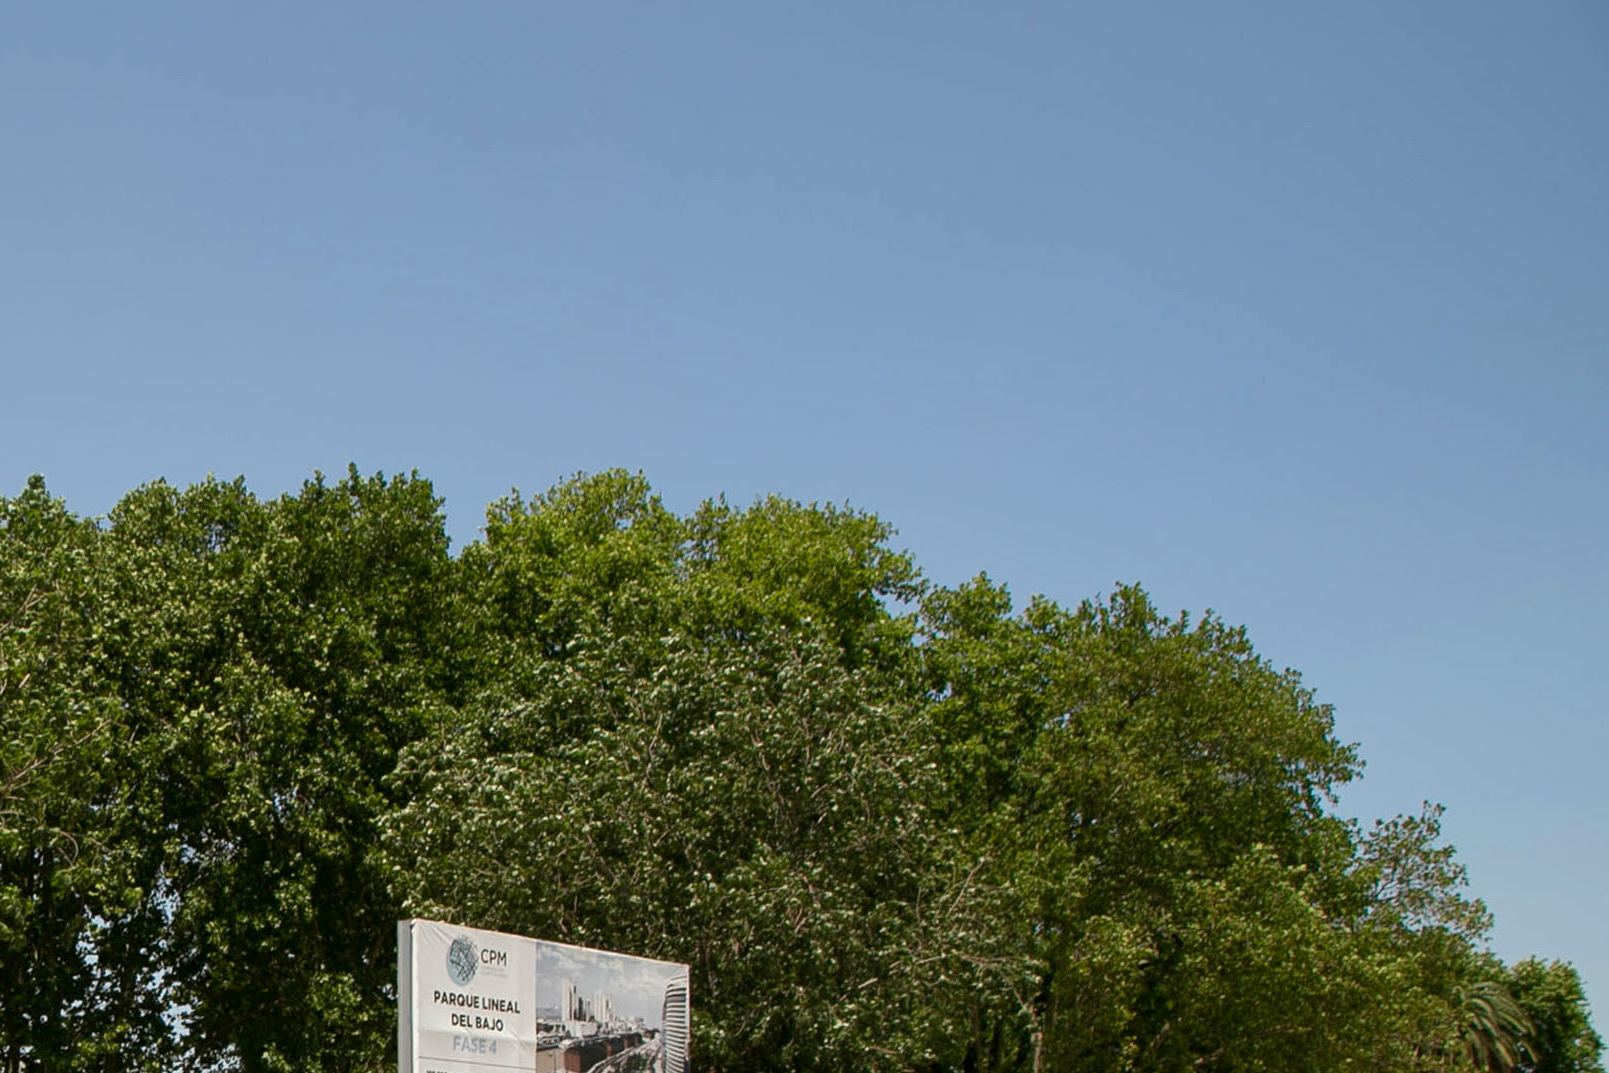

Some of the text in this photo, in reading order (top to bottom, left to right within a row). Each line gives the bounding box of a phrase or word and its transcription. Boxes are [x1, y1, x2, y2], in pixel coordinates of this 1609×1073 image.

[480, 948, 507, 966] CPM
[433, 990, 521, 1014] PARQUE LINEAL
[451, 1013, 504, 1032] DEL BAJO
[453, 1036, 497, 1055] FASE 4
